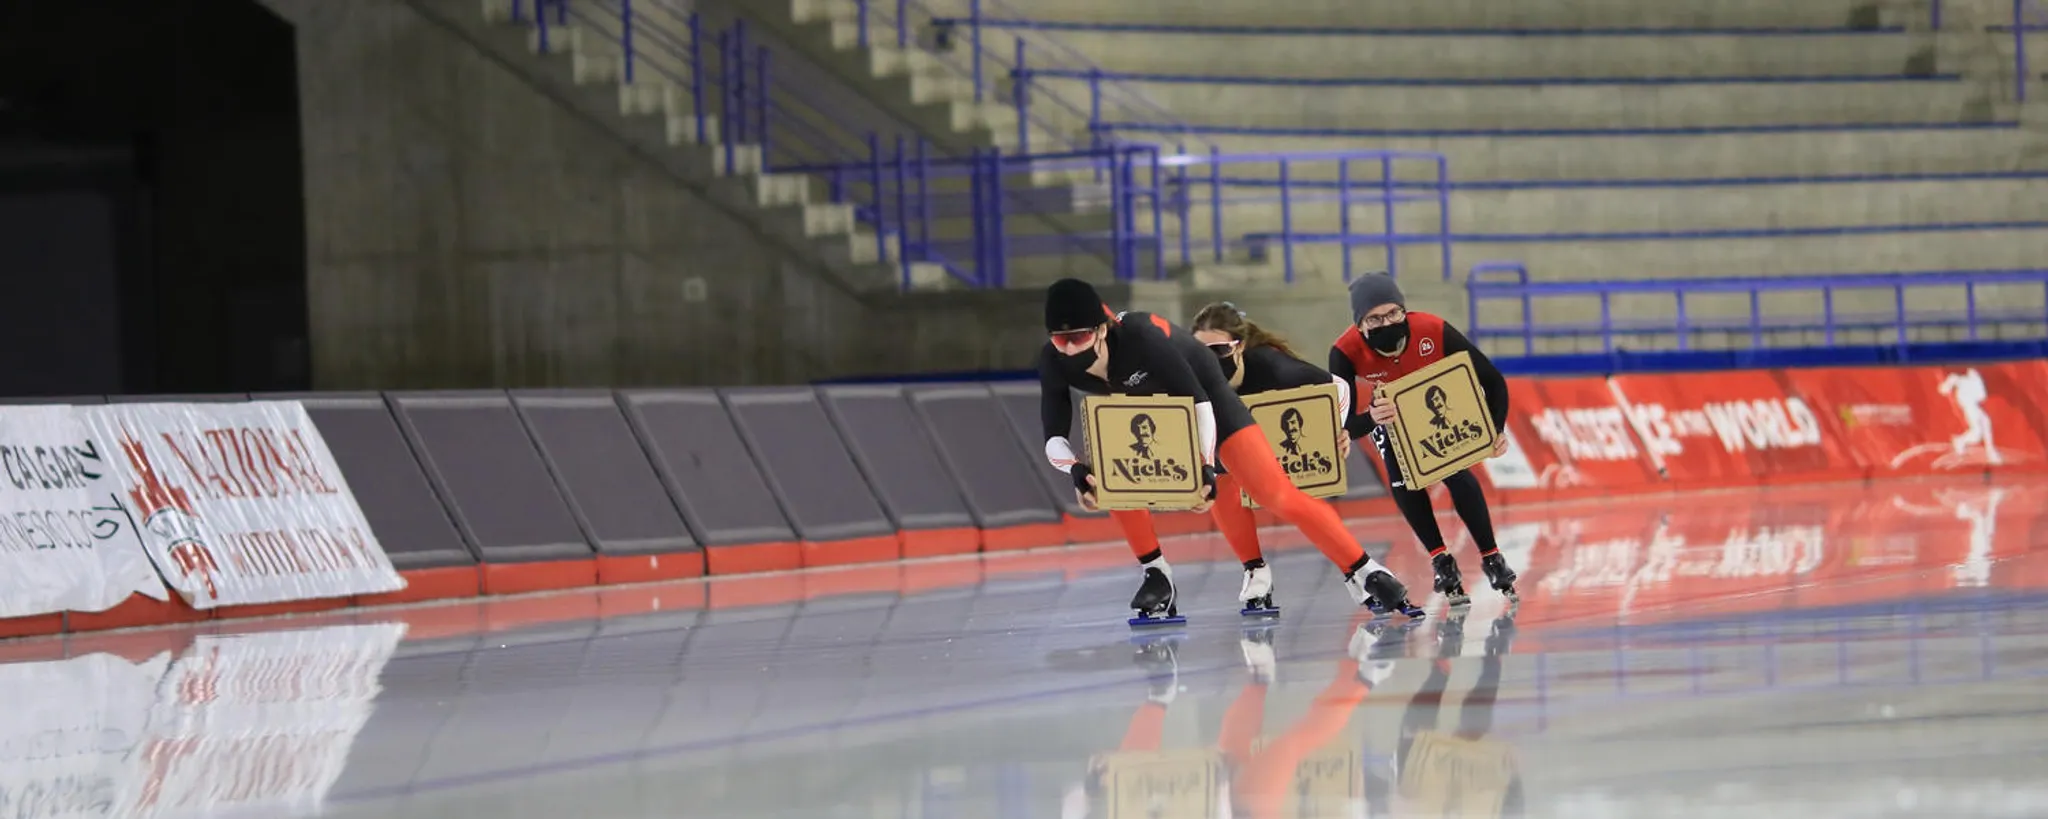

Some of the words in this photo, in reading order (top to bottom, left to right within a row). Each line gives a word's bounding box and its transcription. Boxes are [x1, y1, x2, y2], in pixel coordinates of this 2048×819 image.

[1419, 419, 1483, 459] Nick's
[1703, 397, 1821, 453] WORLD
[0, 439, 102, 490] CALGARY
[160, 427, 338, 500] NATIONAL
[1112, 458, 1188, 484] Nick's
[1277, 451, 1332, 478] ick's
[218, 528, 311, 578] MOTOR
